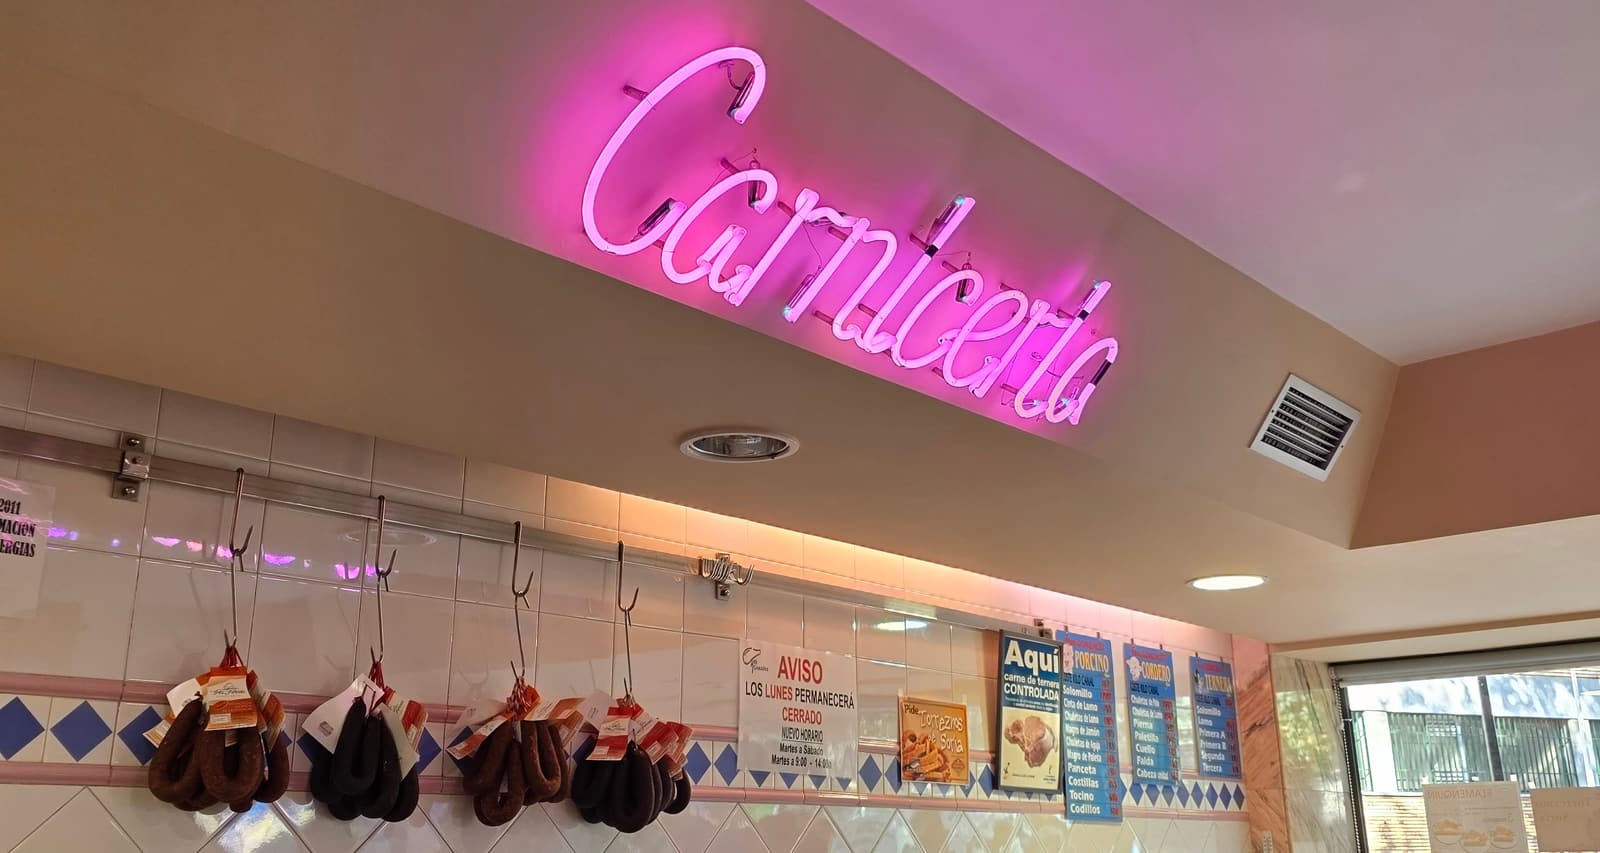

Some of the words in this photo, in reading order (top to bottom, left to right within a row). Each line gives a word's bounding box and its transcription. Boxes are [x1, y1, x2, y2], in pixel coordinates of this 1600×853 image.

[1004, 640, 1059, 676] Aquí
[1074, 650, 1109, 673] PORCINO
[777, 655, 823, 685] AVISO
[1004, 673, 1025, 682] carne
[1027, 675, 1036, 684] de
[1037, 677, 1060, 689] ternera
[745, 680, 763, 697] LOS
[765, 683, 793, 701] LUNES
[795, 687, 854, 709] PERMANECERÁ
[1004, 683, 1060, 701] CONTROLADA
[1063, 684, 1093, 699] Solomillo
[782, 706, 823, 725] CERRADO
[781, 727, 799, 740] NUEVO
[800, 728, 823, 742] HORARIO
[779, 742, 798, 754] Martes
[798, 746, 803, 754] a
[771, 753, 790, 766] Martes
[1067, 762, 1097, 775] Panceta
[1068, 775, 1099, 788] Costillas
[1069, 789, 1094, 801] Tocino
[1070, 803, 1101, 814] Codillos
